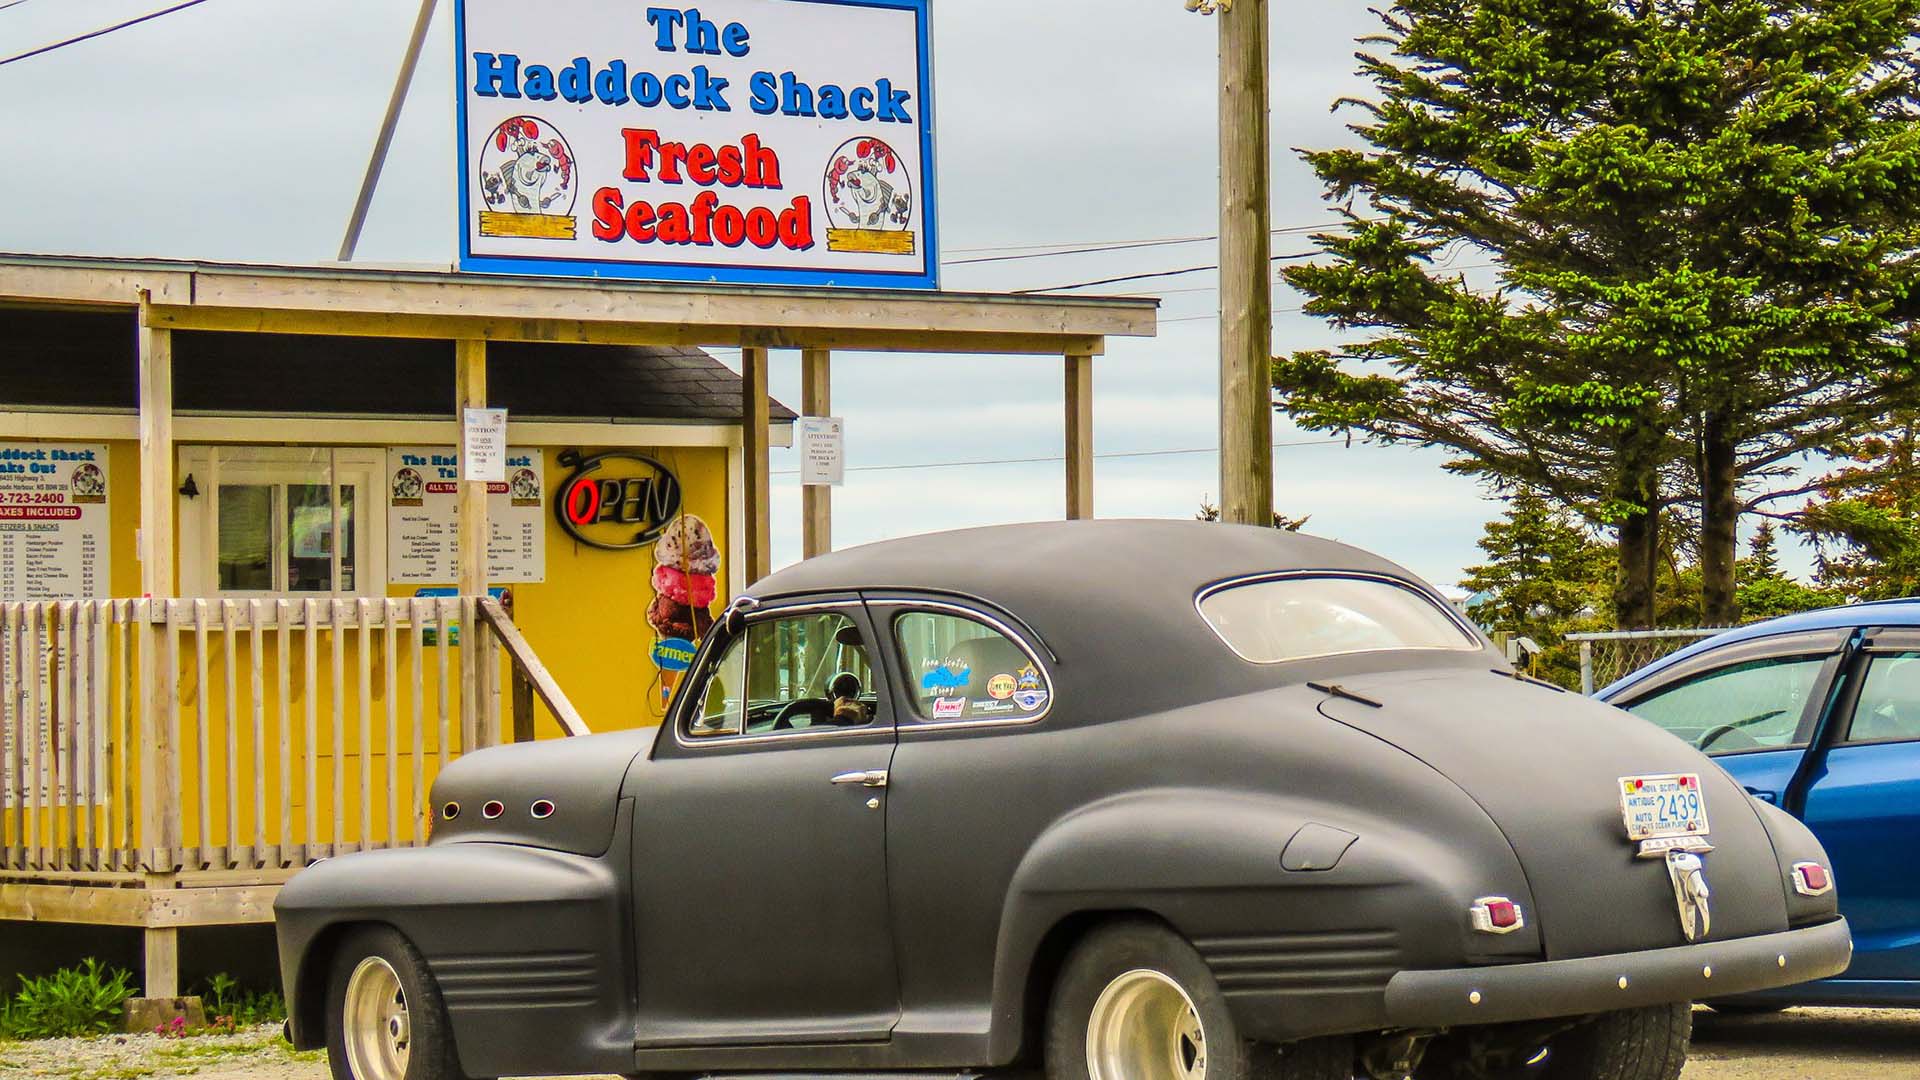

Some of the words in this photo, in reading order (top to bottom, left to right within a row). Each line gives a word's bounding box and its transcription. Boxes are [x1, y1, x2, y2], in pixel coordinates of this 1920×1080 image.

[647, 7, 750, 57] The
[473, 52, 731, 111] Haddock
[749, 70, 912, 123] Shack
[620, 127, 782, 189] Fresh
[591, 186, 815, 251] Seafood
[0, 448, 47, 461] ddock
[51, 449, 96, 461] Shack
[402, 455, 427, 466] The
[505, 455, 532, 467] ack
[30, 462, 57, 474] Out
[438, 467, 457, 479] Ta
[567, 477, 672, 526] OPEN
[26, 508, 78, 517] INCLUDED
[935, 700, 962, 713] SUMMIT
[1628, 796, 1656, 807] ANTIQUE
[1656, 793, 1698, 822] 2439
[1635, 812, 1653, 823] AUTO
